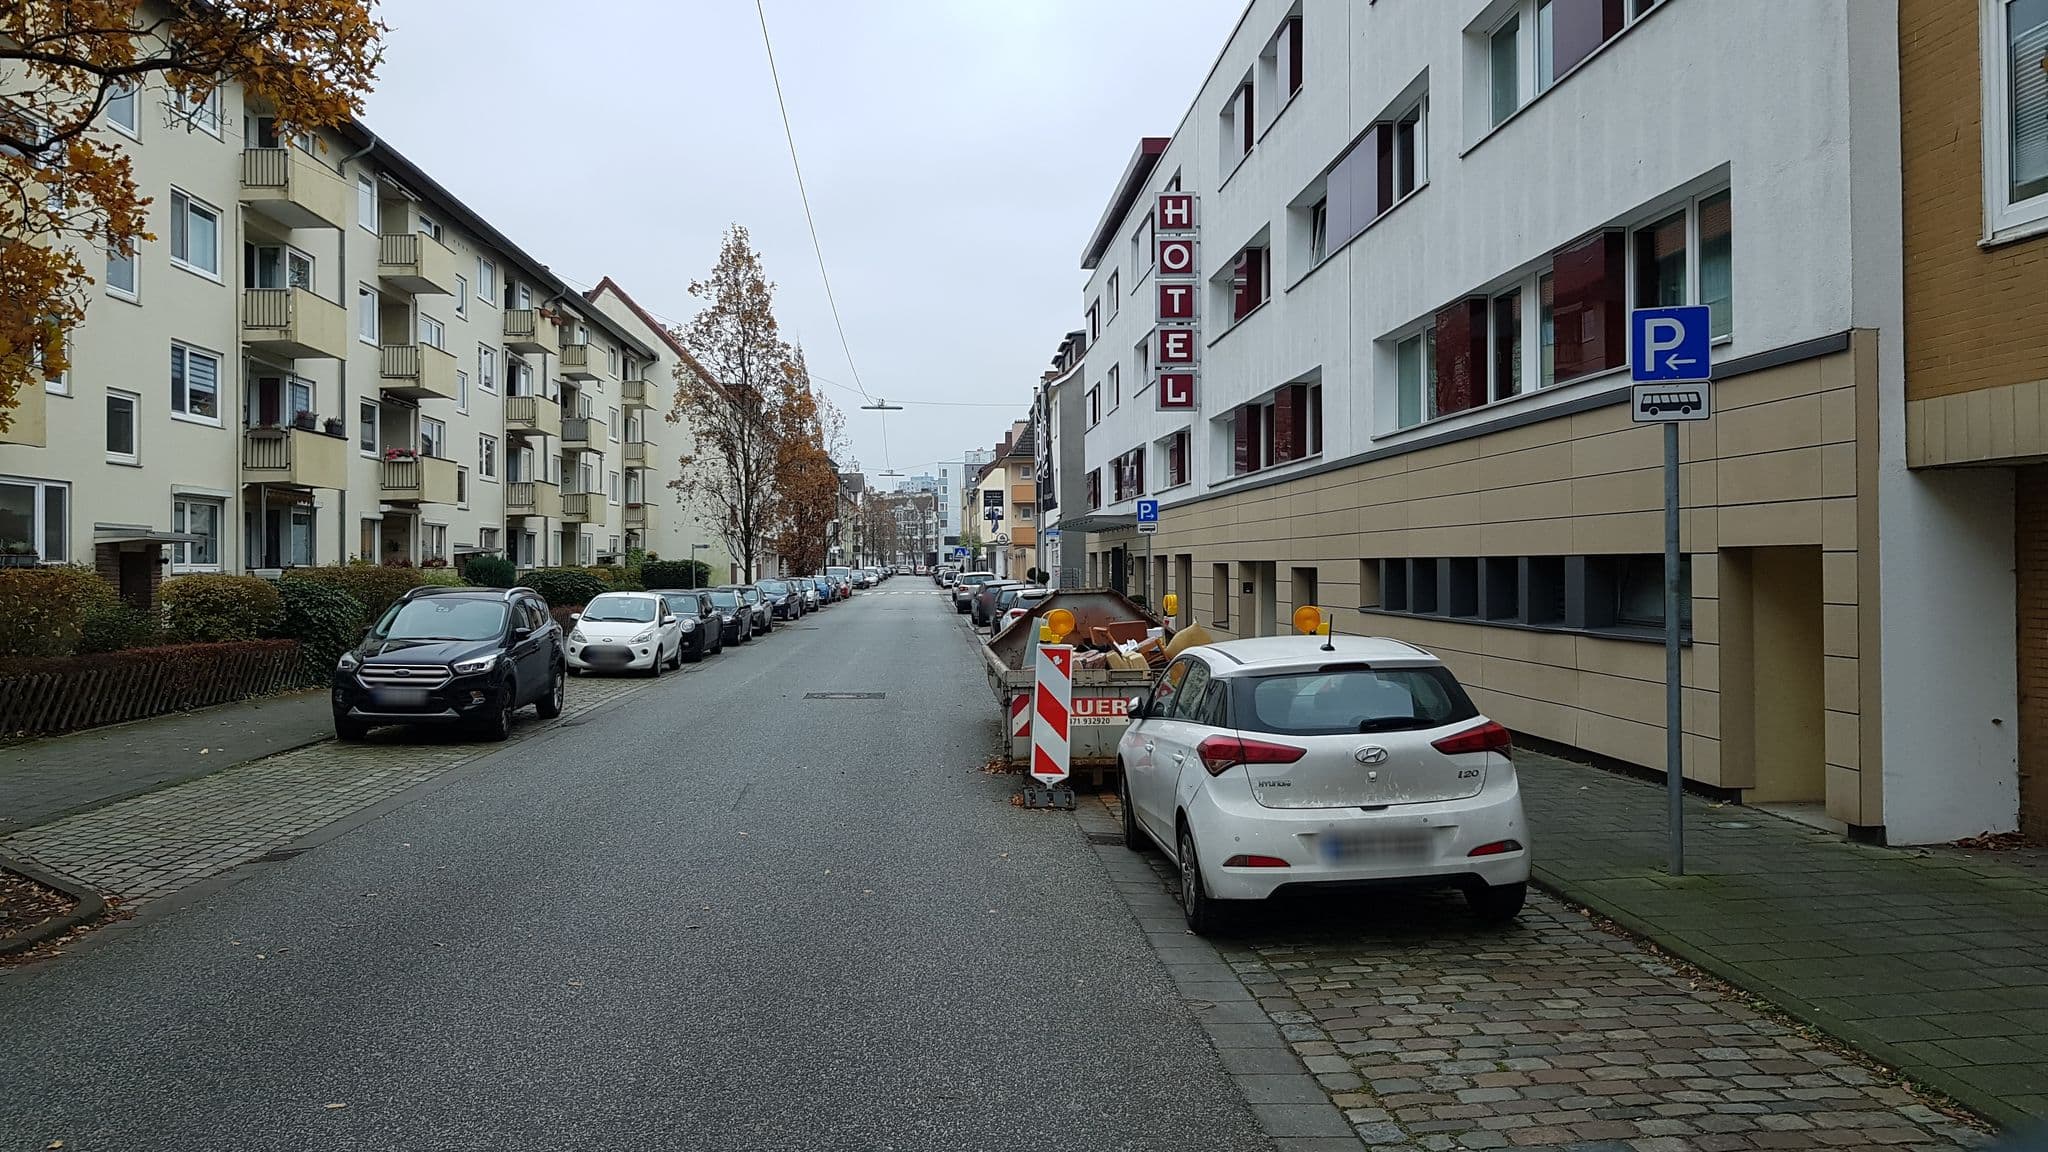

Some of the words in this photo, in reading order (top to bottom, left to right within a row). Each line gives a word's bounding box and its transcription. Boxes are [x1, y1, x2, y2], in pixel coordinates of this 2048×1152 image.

[1163, 199, 1190, 404] HOTEL
[1645, 318, 1685, 372] P
[1140, 503, 1152, 520] P
[1083, 717, 1110, 725] 932920
